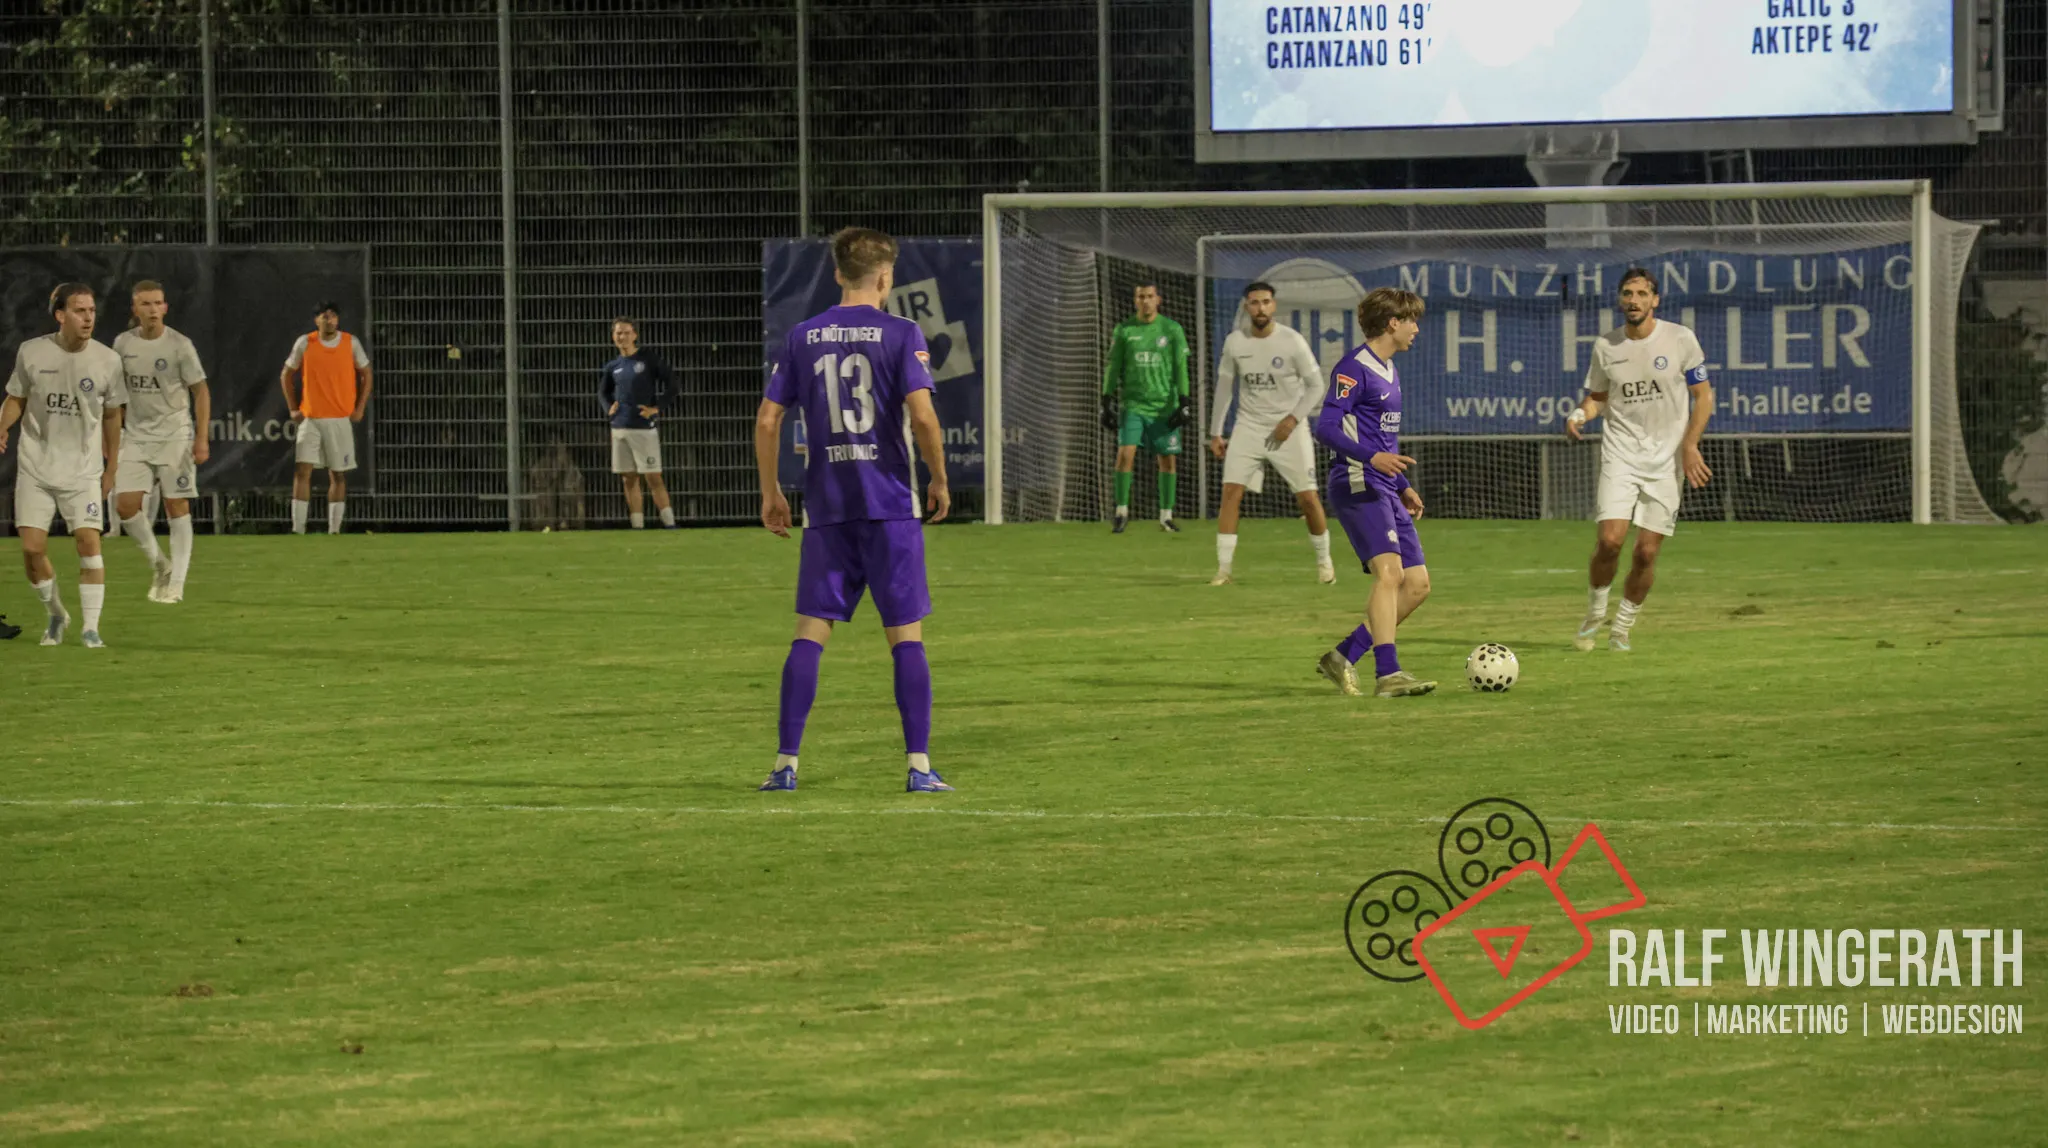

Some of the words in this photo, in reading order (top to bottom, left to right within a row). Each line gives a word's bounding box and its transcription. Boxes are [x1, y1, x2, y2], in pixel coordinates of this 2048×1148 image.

[1266, 4, 1387, 35] CATANZANO
[1266, 39, 1388, 69] CATANZANO
[1751, 25, 1832, 54] AKTEPE
[1400, 254, 1914, 298] MÜNZHNDLUNG
[884, 290, 934, 320] IR
[806, 328, 820, 345] FC
[1445, 310, 1523, 373] H.
[1561, 303, 1872, 372] HLLER
[129, 374, 161, 389] GEA
[813, 353, 875, 434] 13
[1244, 372, 1276, 386] GEA
[1622, 379, 1662, 398] GEA
[46, 392, 80, 410] GEA
[208, 410, 299, 441] nik.co
